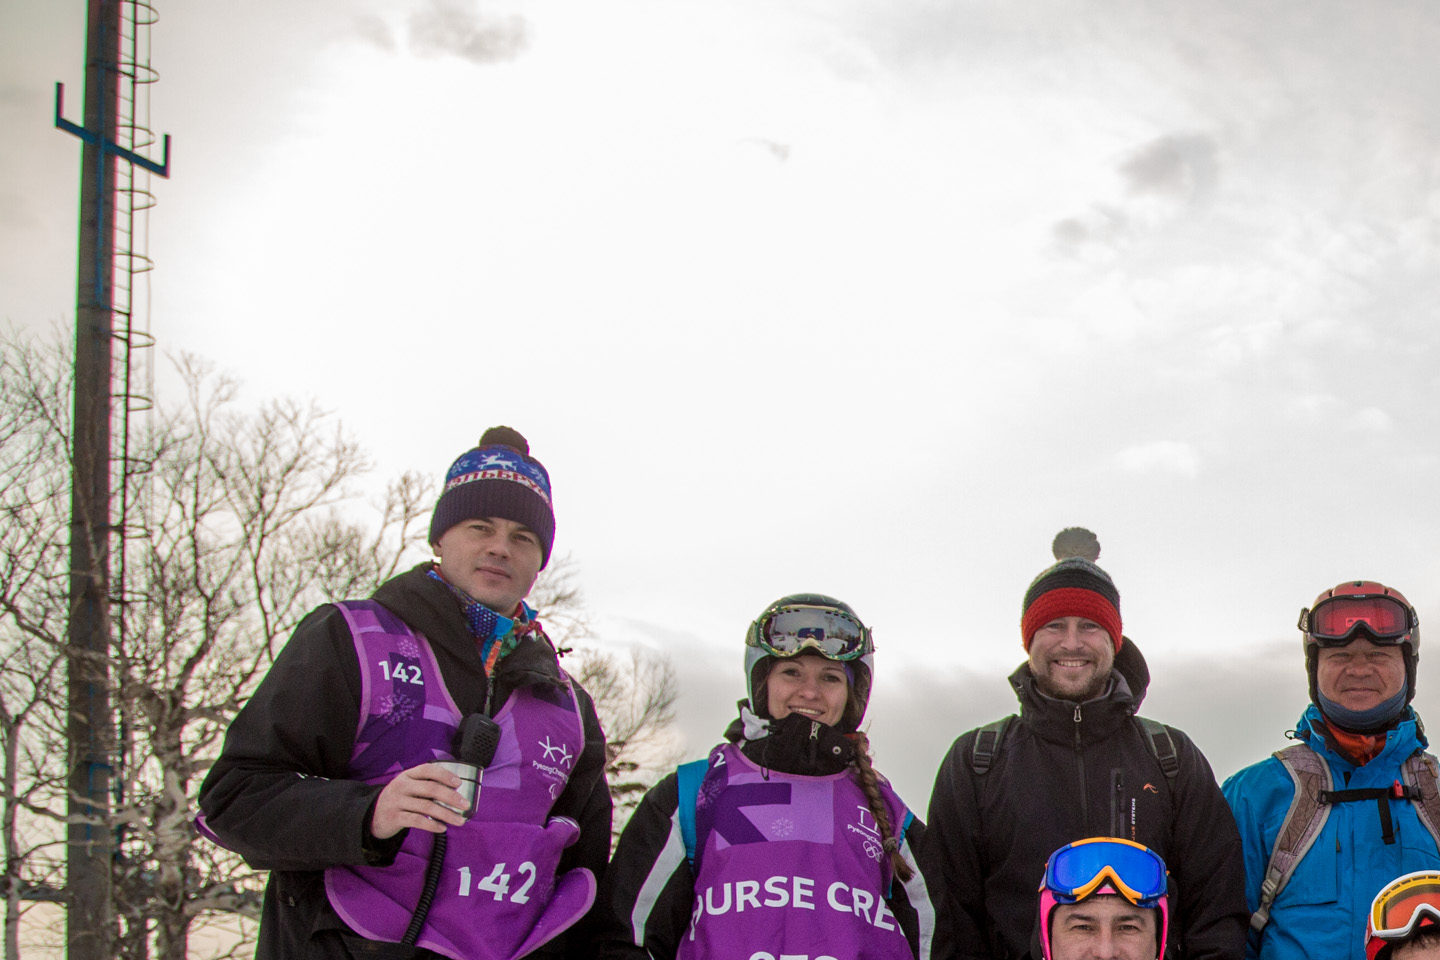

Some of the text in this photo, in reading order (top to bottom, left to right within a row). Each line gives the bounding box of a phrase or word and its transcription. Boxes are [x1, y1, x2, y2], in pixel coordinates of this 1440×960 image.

[378, 660, 424, 685] 142
[457, 861, 536, 905] 142
[826, 881, 905, 936] CRE
